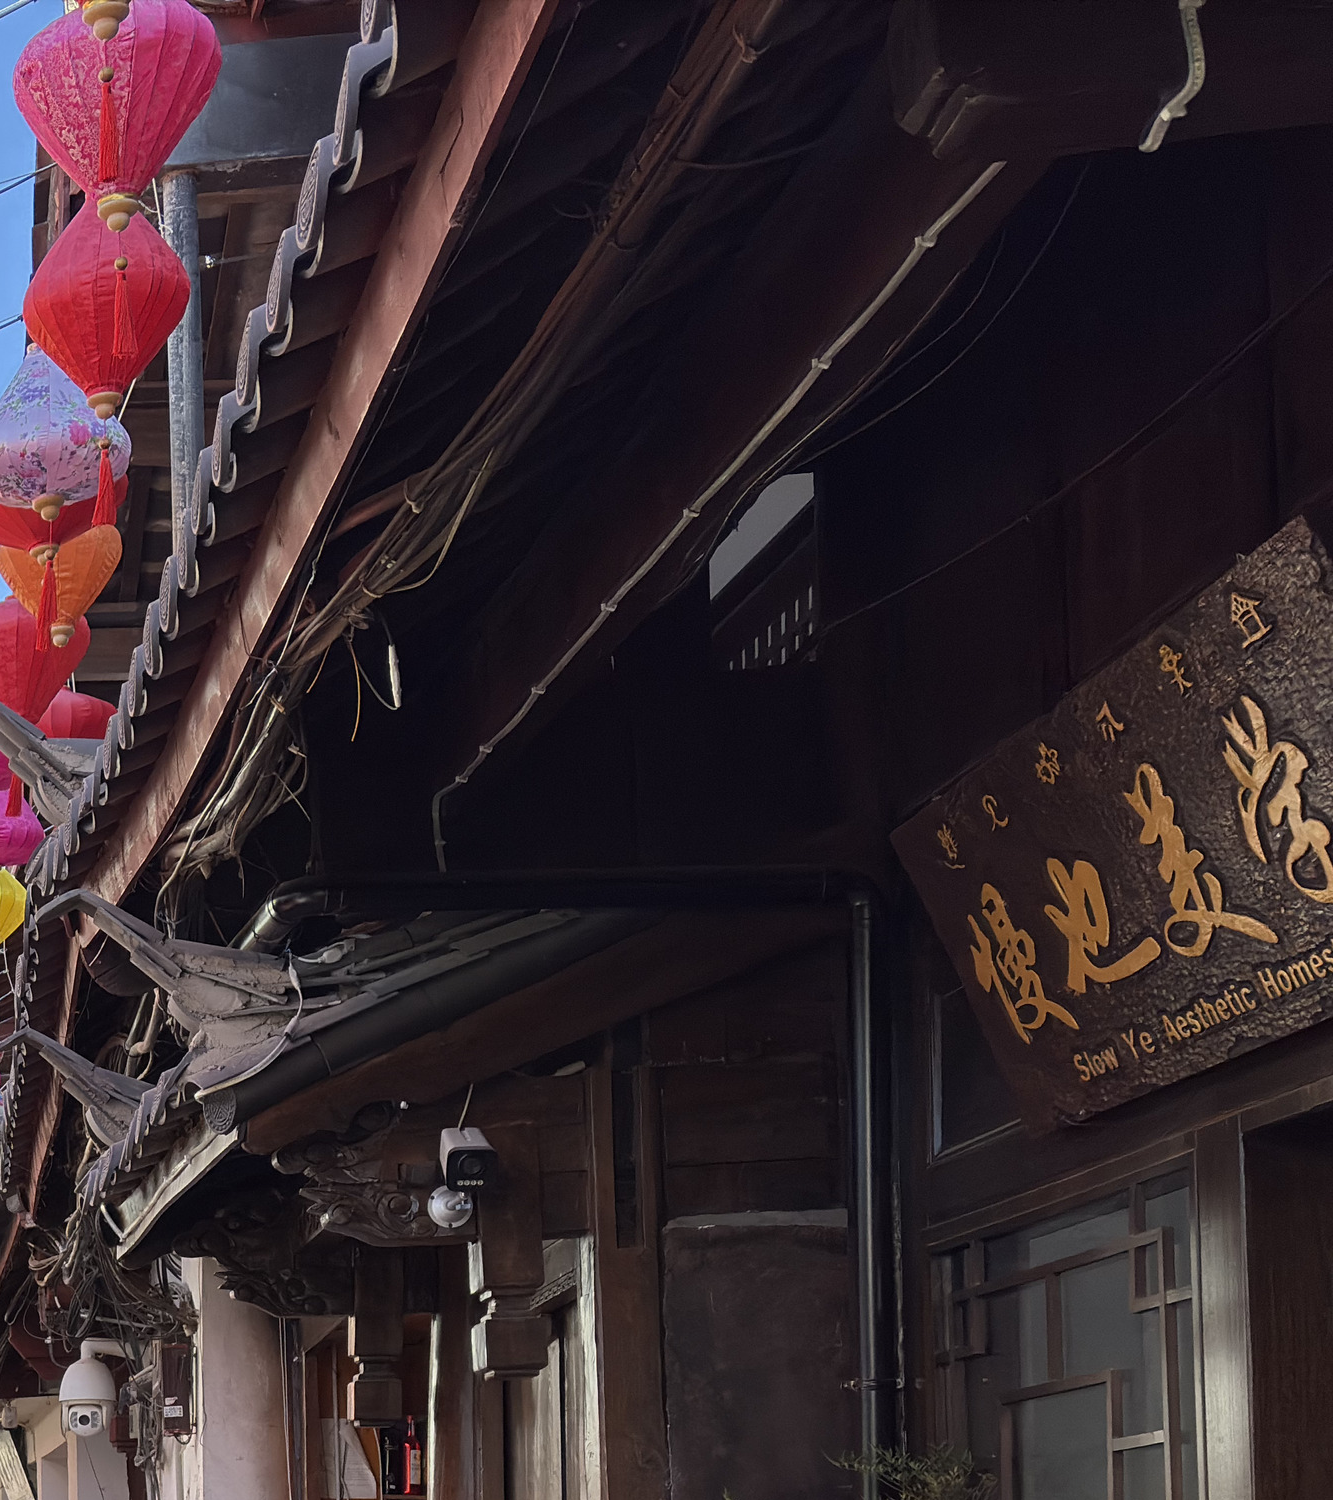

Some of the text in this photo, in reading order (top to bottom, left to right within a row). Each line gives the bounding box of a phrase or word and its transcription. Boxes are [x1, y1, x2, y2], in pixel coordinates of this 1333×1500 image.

[1073, 940, 1333, 1082] Slow Ye Aesthetic Homes
